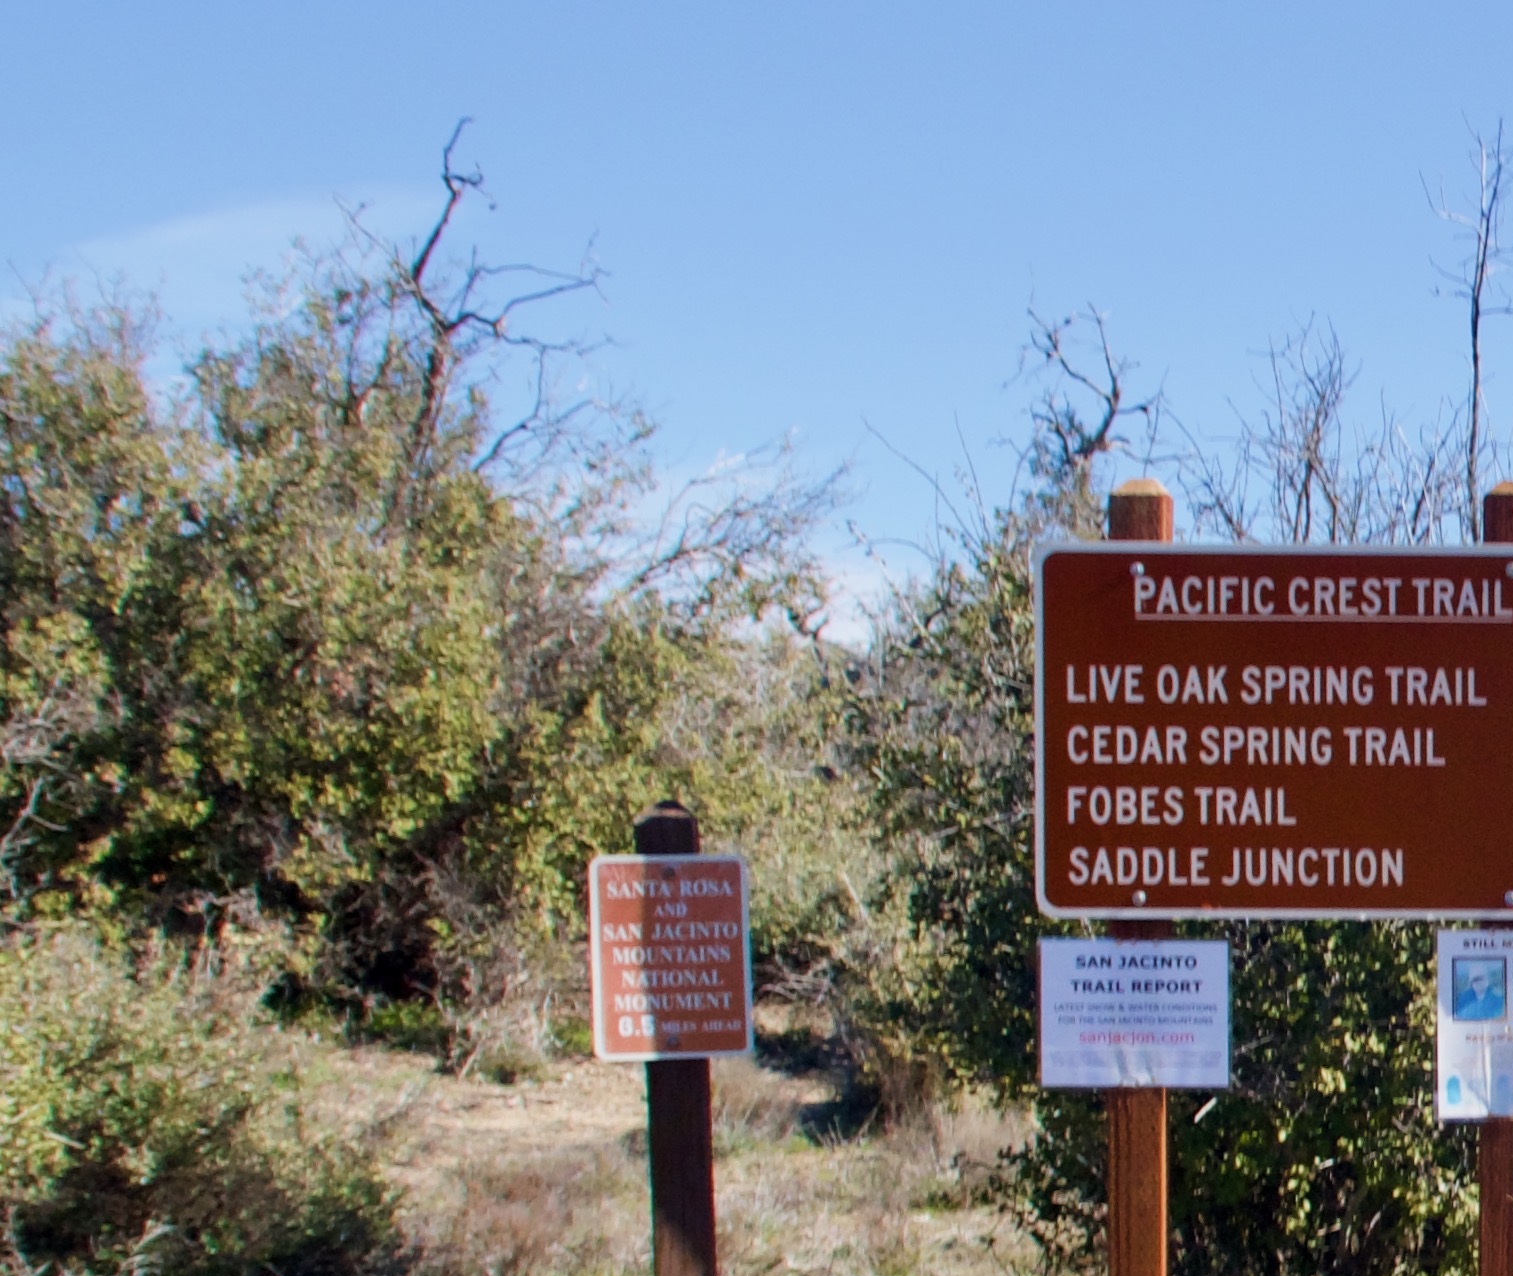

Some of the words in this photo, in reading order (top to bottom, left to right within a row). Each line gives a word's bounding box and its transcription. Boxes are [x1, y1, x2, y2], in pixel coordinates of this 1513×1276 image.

[1134, 576, 1276, 616] PACIFIC
[1288, 577, 1402, 617] CREST
[1412, 578, 1513, 618] TRAIL
[1066, 664, 1144, 705] LIVE
[1157, 665, 1228, 705] OAK
[1240, 665, 1374, 706] SPRING
[1385, 667, 1487, 707] TRAIL
[1067, 726, 1187, 765] CEDAR
[1199, 727, 1333, 766] SPRING
[1343, 728, 1446, 767] TRAIL
[1067, 786, 1184, 826] FOBES
[1195, 787, 1297, 827] TRAIL
[1068, 847, 1210, 887] SADDLE
[1221, 848, 1404, 887] JUNCTION
[607, 880, 671, 899] SANTA
[680, 879, 733, 898] ROSA
[655, 902, 687, 918] AND
[603, 923, 642, 942] SAN
[651, 922, 738, 941] JACINTO
[612, 945, 731, 966] MOUNTAINS
[1076, 955, 1112, 970] SAN
[1118, 955, 1197, 970] JACINTO
[622, 969, 723, 989] NATIONAL
[1071, 980, 1125, 994] TRAIL
[1132, 980, 1203, 994] REPORT
[614, 992, 732, 1013] MONUMENT
